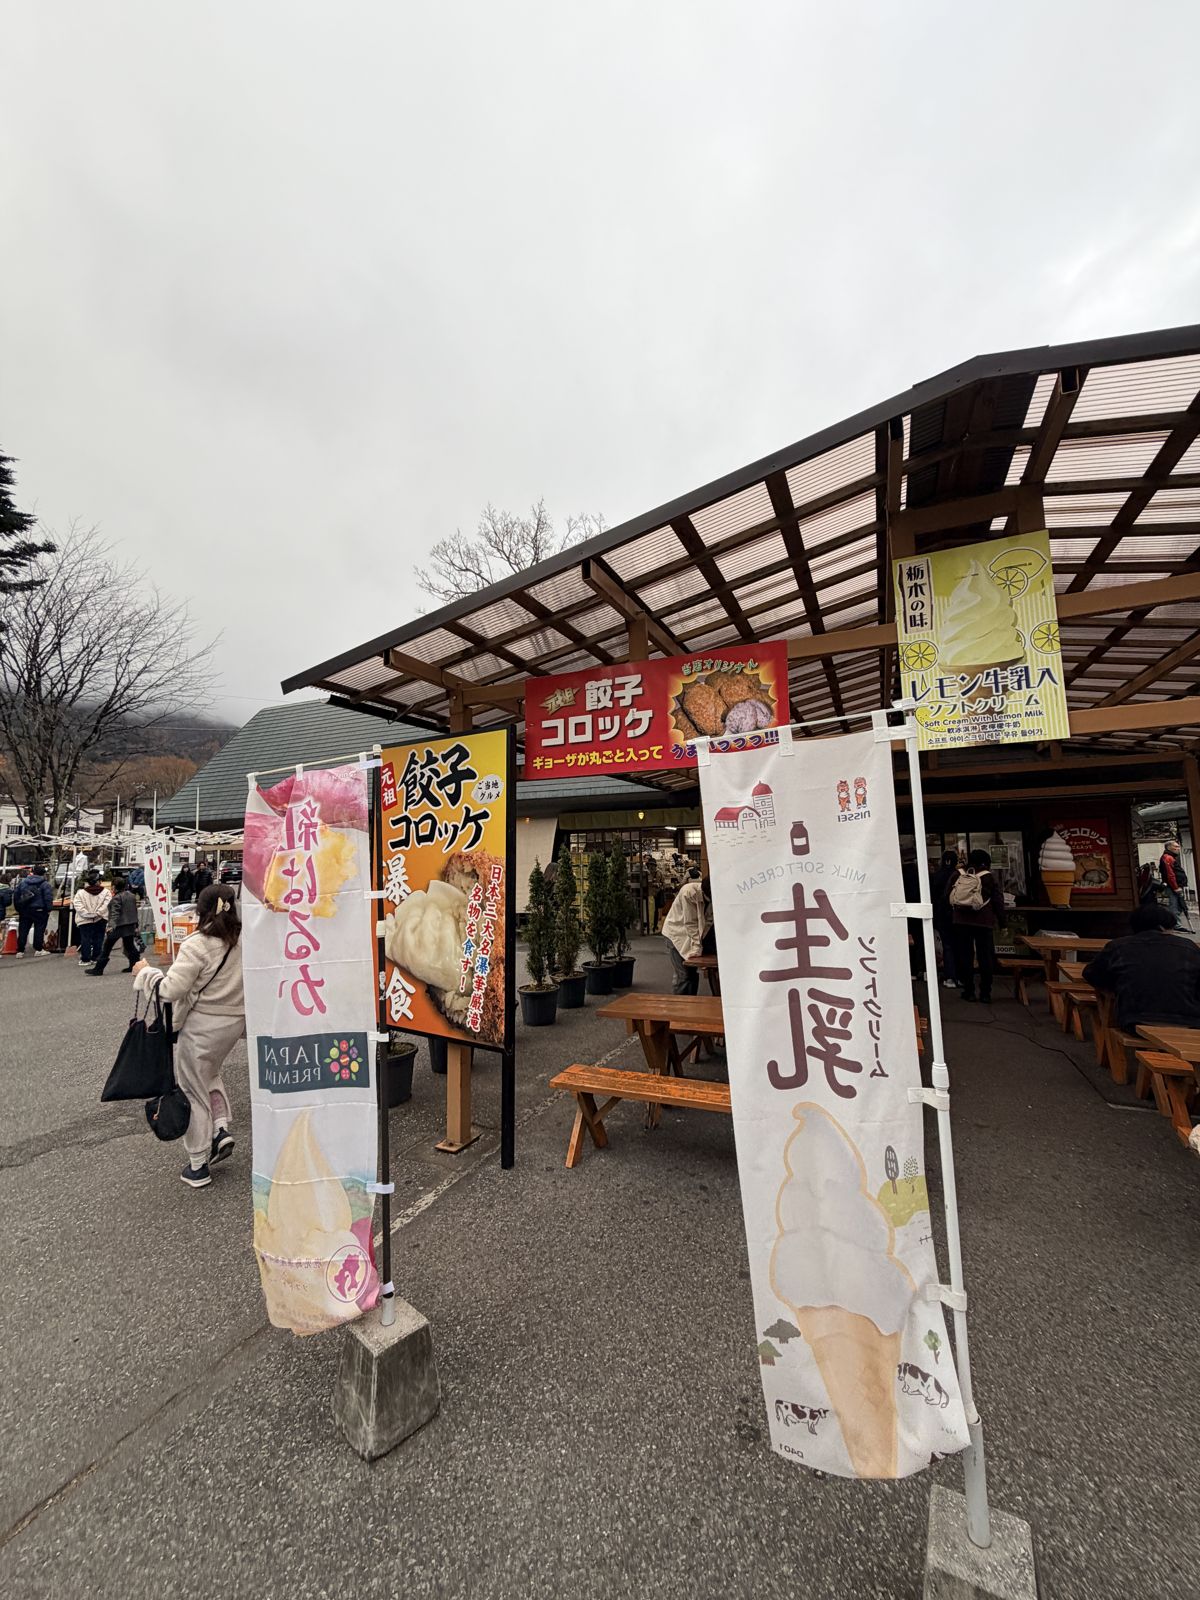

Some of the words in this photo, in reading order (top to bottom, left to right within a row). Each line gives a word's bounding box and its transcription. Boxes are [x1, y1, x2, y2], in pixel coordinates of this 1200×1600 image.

[905, 563, 929, 629] 栃木の味
[585, 674, 643, 712] 餃子
[911, 664, 1059, 702] レモン牛乳入
[924, 720, 940, 728] Soft
[943, 717, 968, 726] Cream
[971, 715, 991, 723] With
[993, 713, 1022, 721] Lemon
[1024, 709, 1045, 717] Milk
[928, 693, 1041, 719] ソフトクリーム
[540, 707, 653, 748] コロッケ
[927, 737, 948, 745] 소프트
[532, 744, 664, 770] ギョーザが丸ごと入って
[381, 767, 397, 807] 元祖
[397, 742, 478, 812] 餃子
[477, 779, 500, 792] ご当地
[479, 790, 501, 802] グルメ
[388, 804, 491, 853] コロッケ
